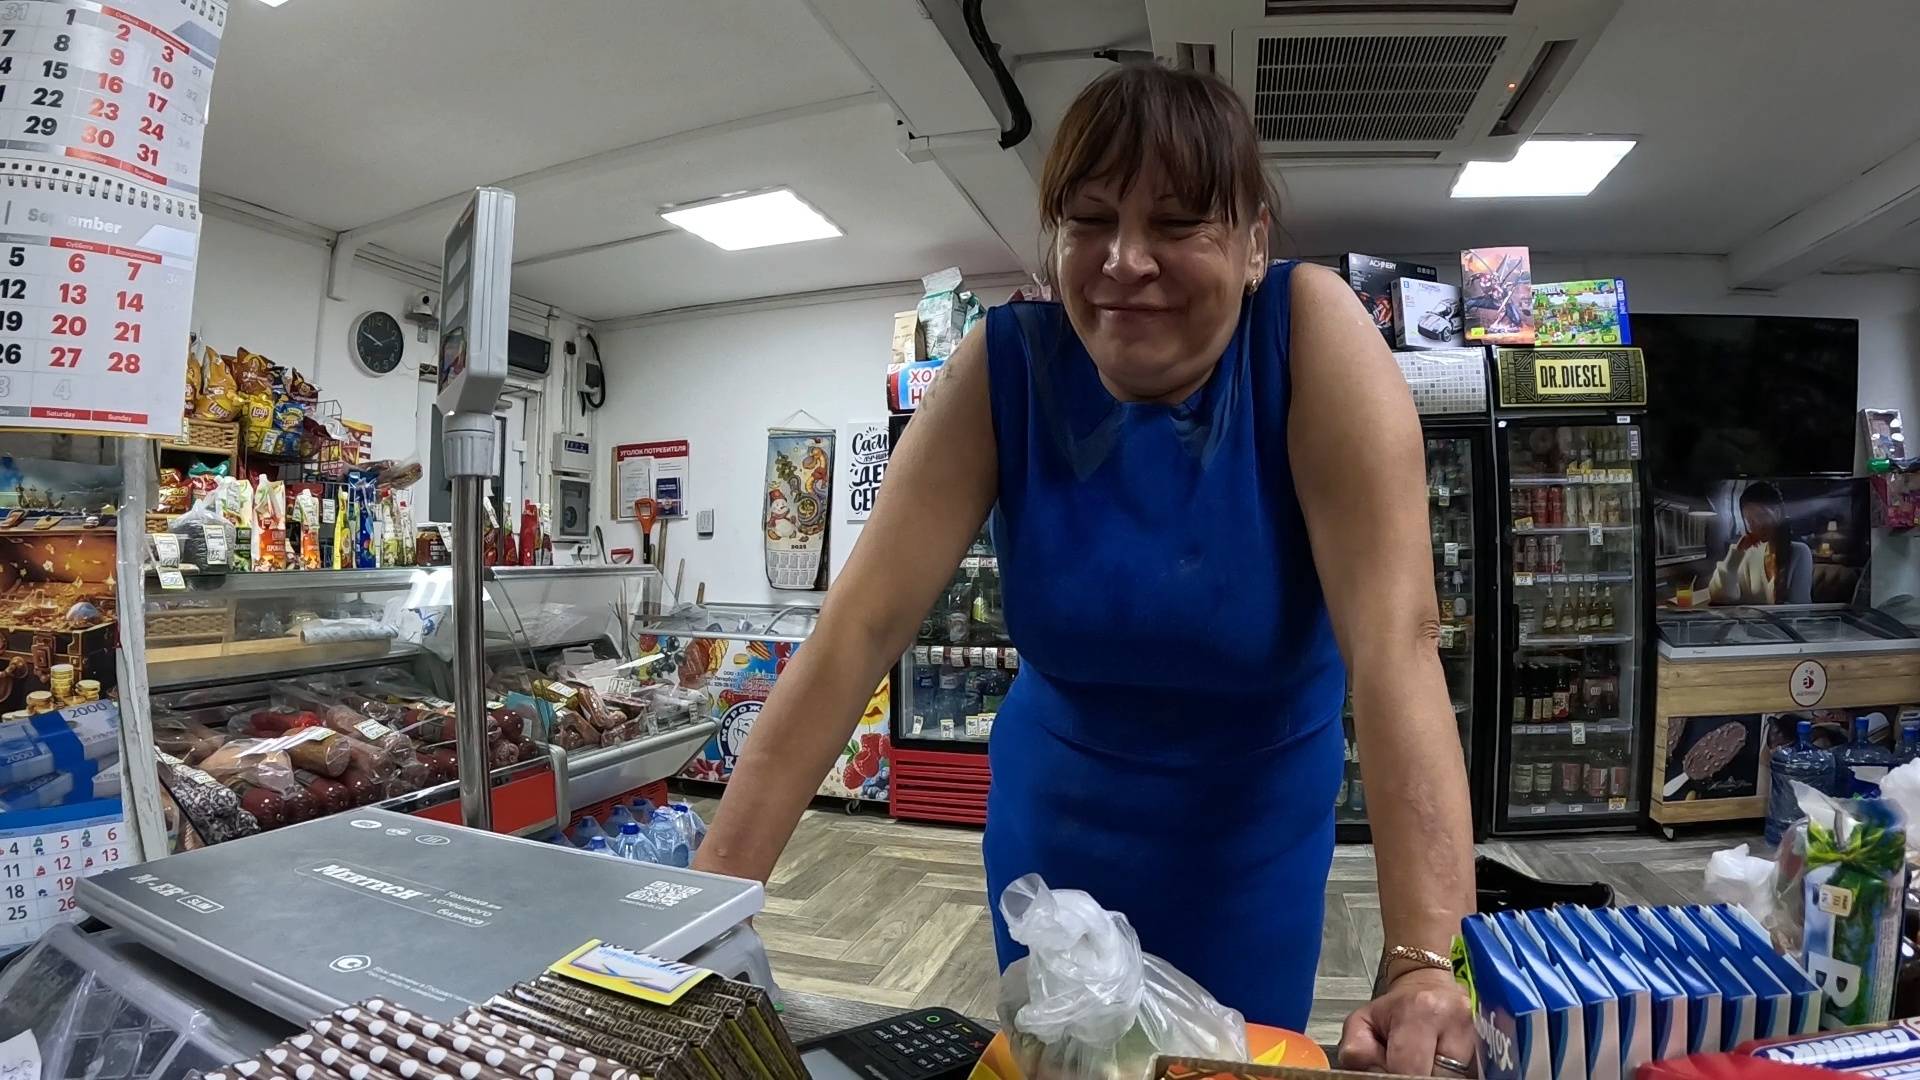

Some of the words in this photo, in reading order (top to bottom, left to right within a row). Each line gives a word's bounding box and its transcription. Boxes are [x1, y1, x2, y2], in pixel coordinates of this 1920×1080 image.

[66, 9, 77, 25] 1
[1, 29, 16, 46] 7
[53, 34, 71, 52] 8
[115, 24, 131, 42] 2
[42, 60, 69, 79] 15
[109, 48, 125, 66] 9
[162, 46, 175, 63] 3
[30, 87, 65, 108] 22
[97, 72, 124, 94] 16
[152, 66, 174, 90] 10
[23, 115, 58, 136] 29
[88, 98, 120, 121] 23
[147, 92, 168, 113] 17
[81, 124, 115, 148] 30
[138, 116, 165, 141] 24
[136, 143, 160, 166] 31
[8, 246, 25, 267] 5
[68, 253, 85, 273] 6
[127, 262, 142, 281] 7
[0, 279, 27, 299] 12
[58, 283, 87, 305] 13
[116, 291, 144, 312] 14
[0, 311, 23, 331] 19
[50, 315, 87, 336] 20
[114, 322, 141, 343] 21
[48, 347, 82, 368] 27
[107, 352, 141, 374] 28
[1540, 364, 1606, 388] DR.DIESEL
[69, 702, 108, 718] 2000
[721, 703, 764, 742] МОРОЖ
[9, 842, 20, 855] 4
[60, 835, 69, 849] 5
[107, 827, 117, 841] 6
[3, 864, 20, 878] 11
[54, 856, 72, 870] 12
[101, 847, 119, 861] 13
[6, 884, 25, 899] 18
[57, 877, 74, 891] 19
[312, 864, 423, 900] MERTECH
[8, 905, 27, 921] 25
[57, 896, 76, 912] 26
[1766, 1028, 1911, 1064] CHUNKY
